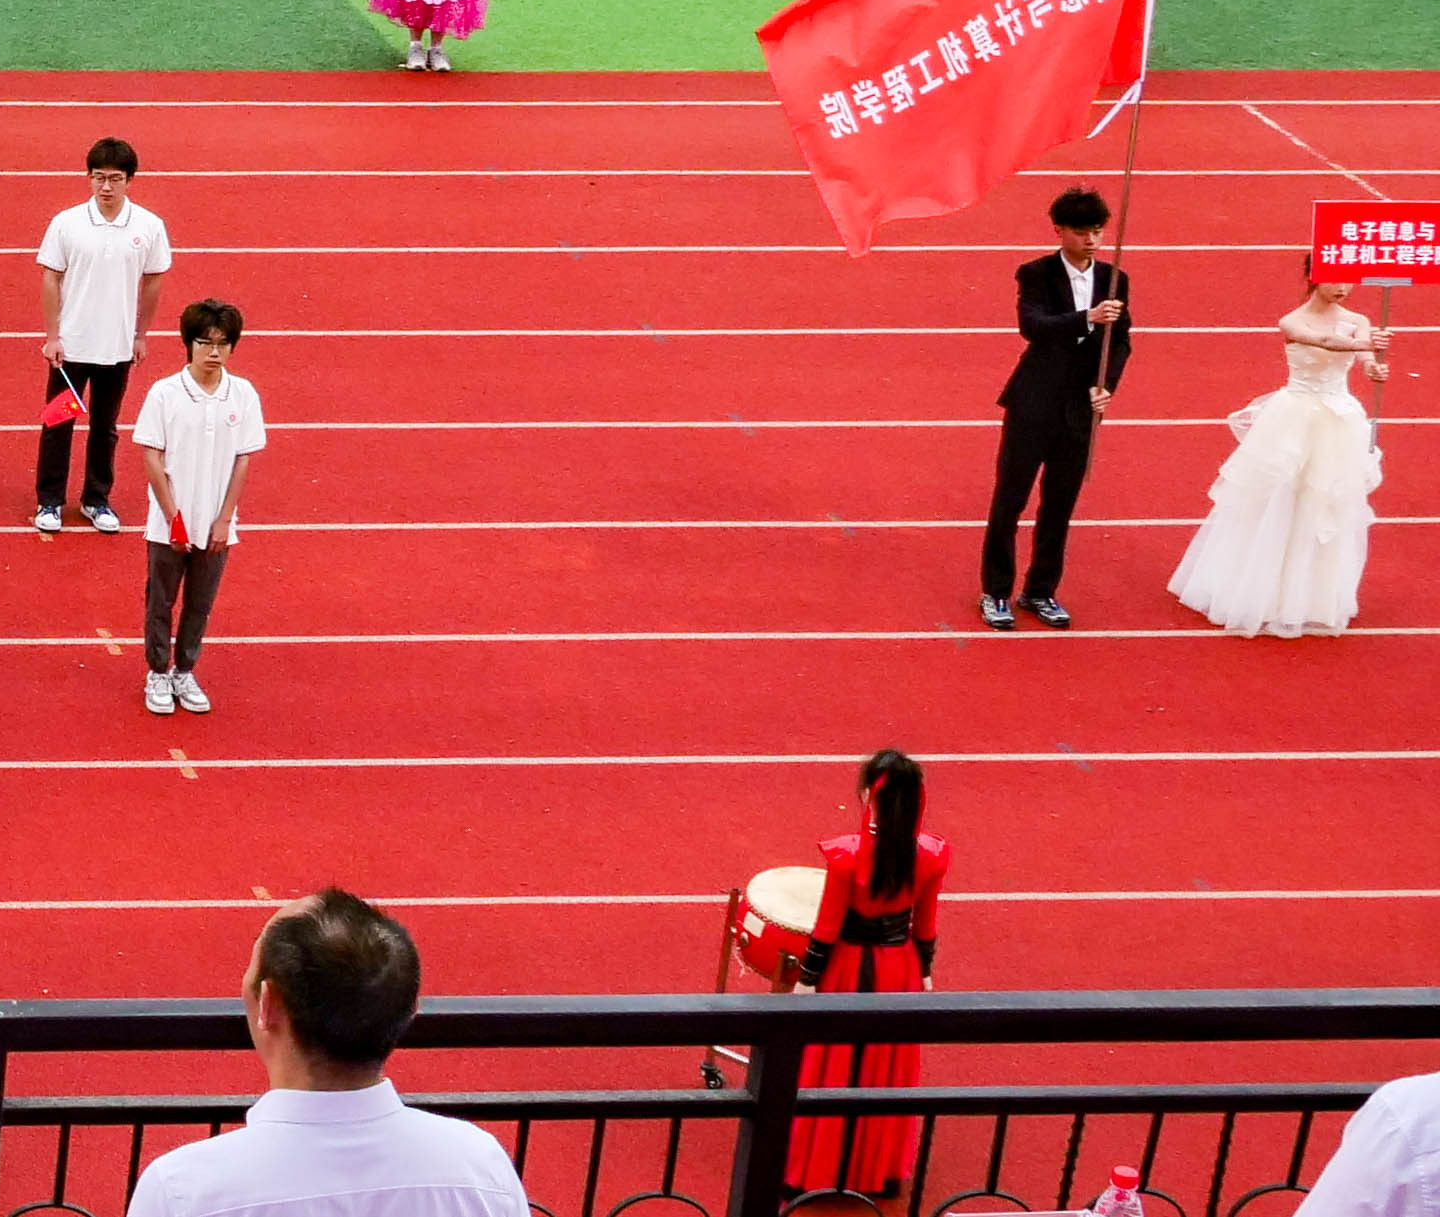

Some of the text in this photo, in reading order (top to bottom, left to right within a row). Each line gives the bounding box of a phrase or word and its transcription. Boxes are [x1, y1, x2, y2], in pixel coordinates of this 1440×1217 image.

[1341, 220, 1436, 241] 电子信息与
[1320, 244, 1440, 265] 计算机工程学
